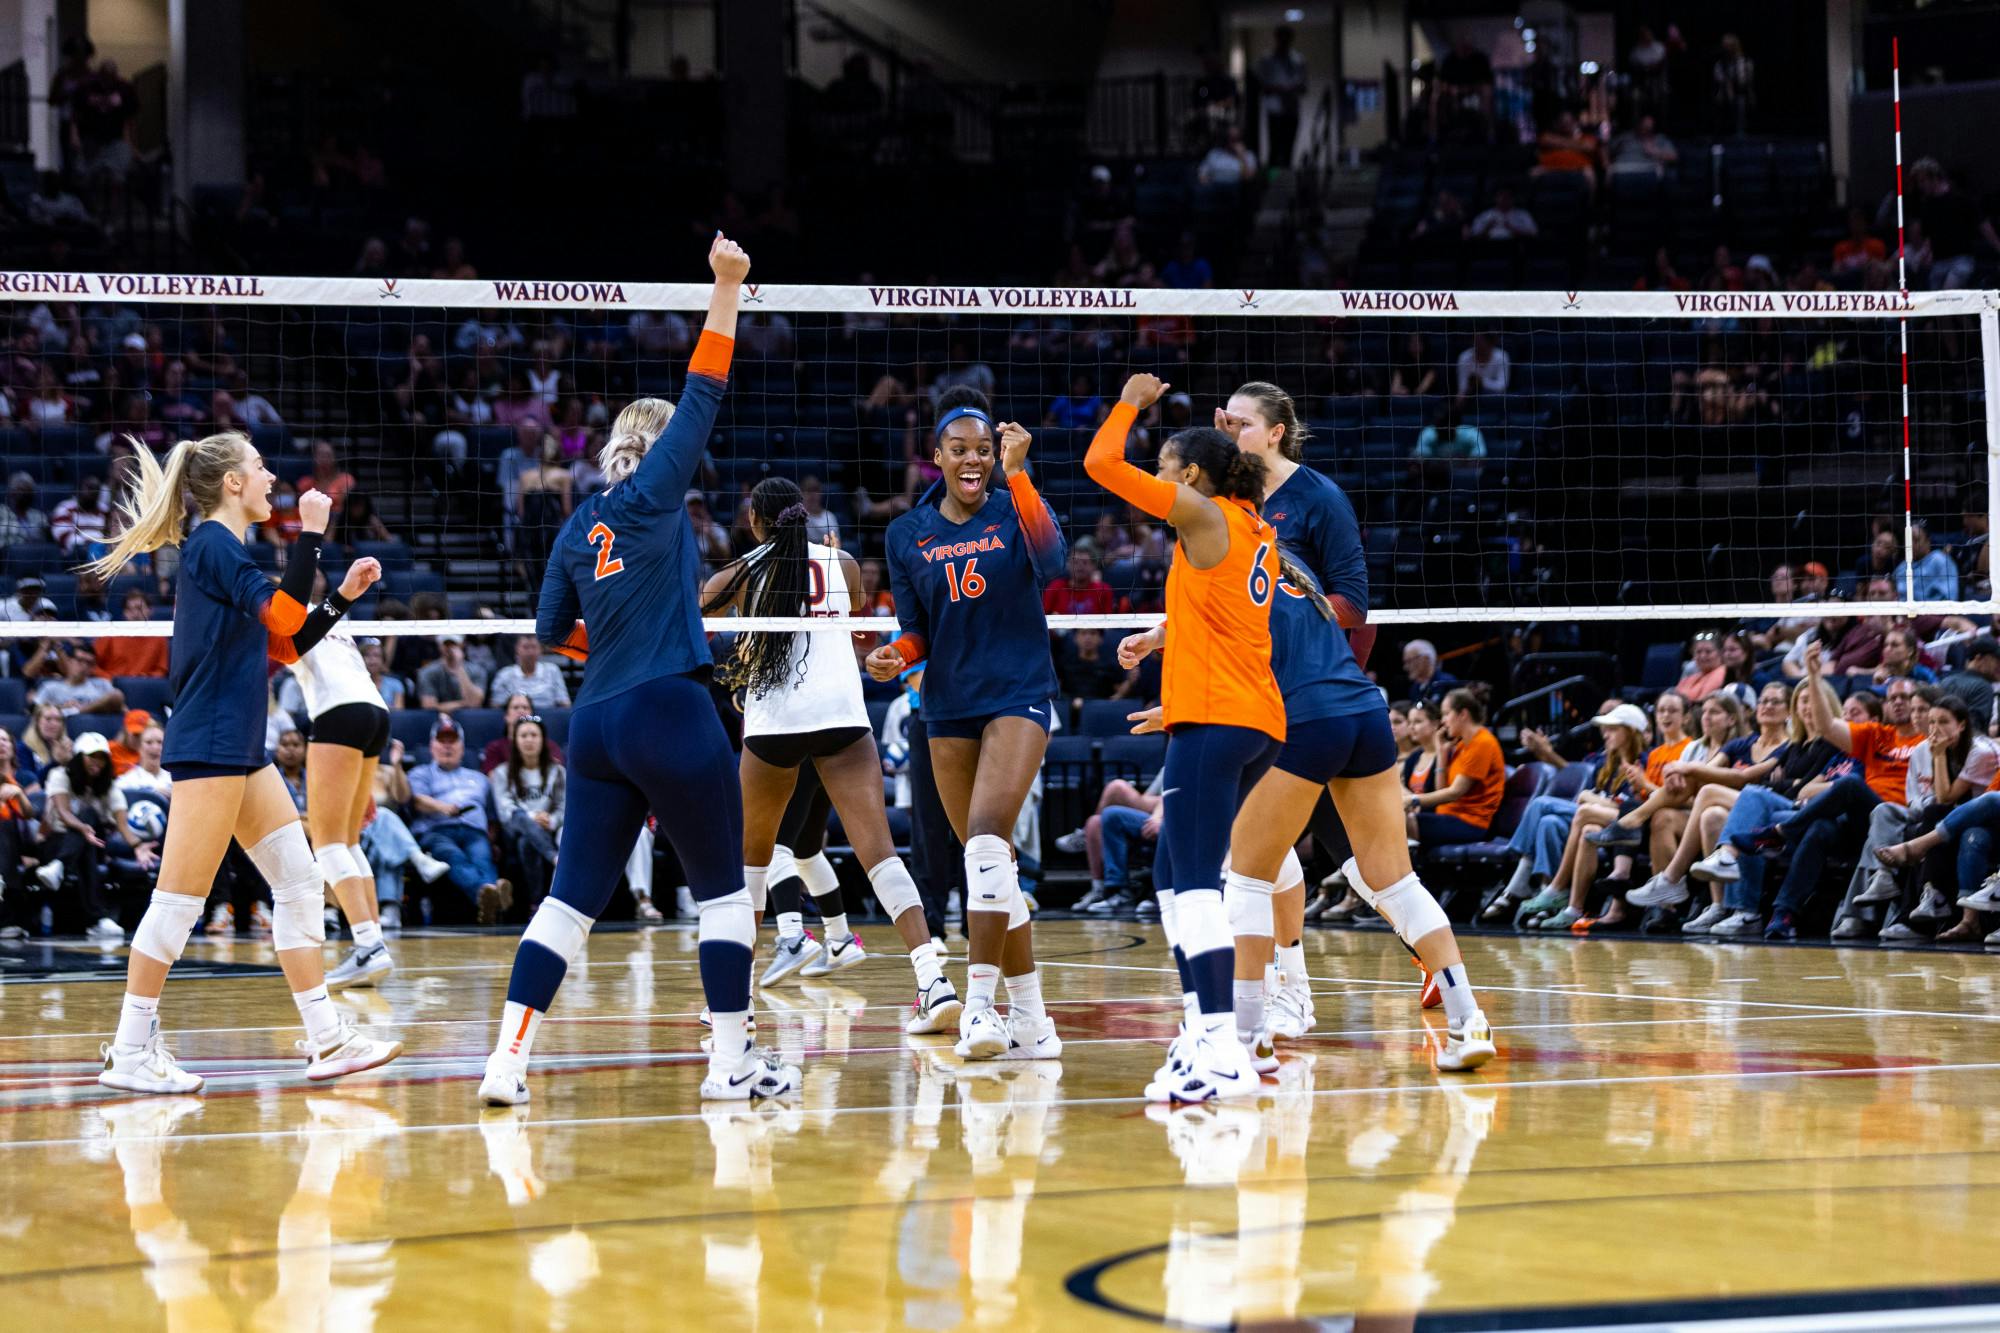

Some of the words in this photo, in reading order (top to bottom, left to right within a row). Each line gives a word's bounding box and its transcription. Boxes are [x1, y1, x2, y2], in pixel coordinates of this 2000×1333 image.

[97, 275, 265, 297] VOLLEYBALL
[493, 281, 627, 303] WAHOOWA
[869, 287, 982, 308] VIRGINIA
[988, 288, 1137, 308] VOLLEYBALL
[1340, 291, 1460, 311] WAHOOWA
[1675, 294, 1776, 312] VIRGINIA
[1781, 294, 1915, 312] VOLLEYBALL
[587, 521, 625, 581] 2
[921, 534, 1006, 564] VIRGINIA
[944, 557, 987, 602] 16
[1247, 542, 1271, 607] 6
